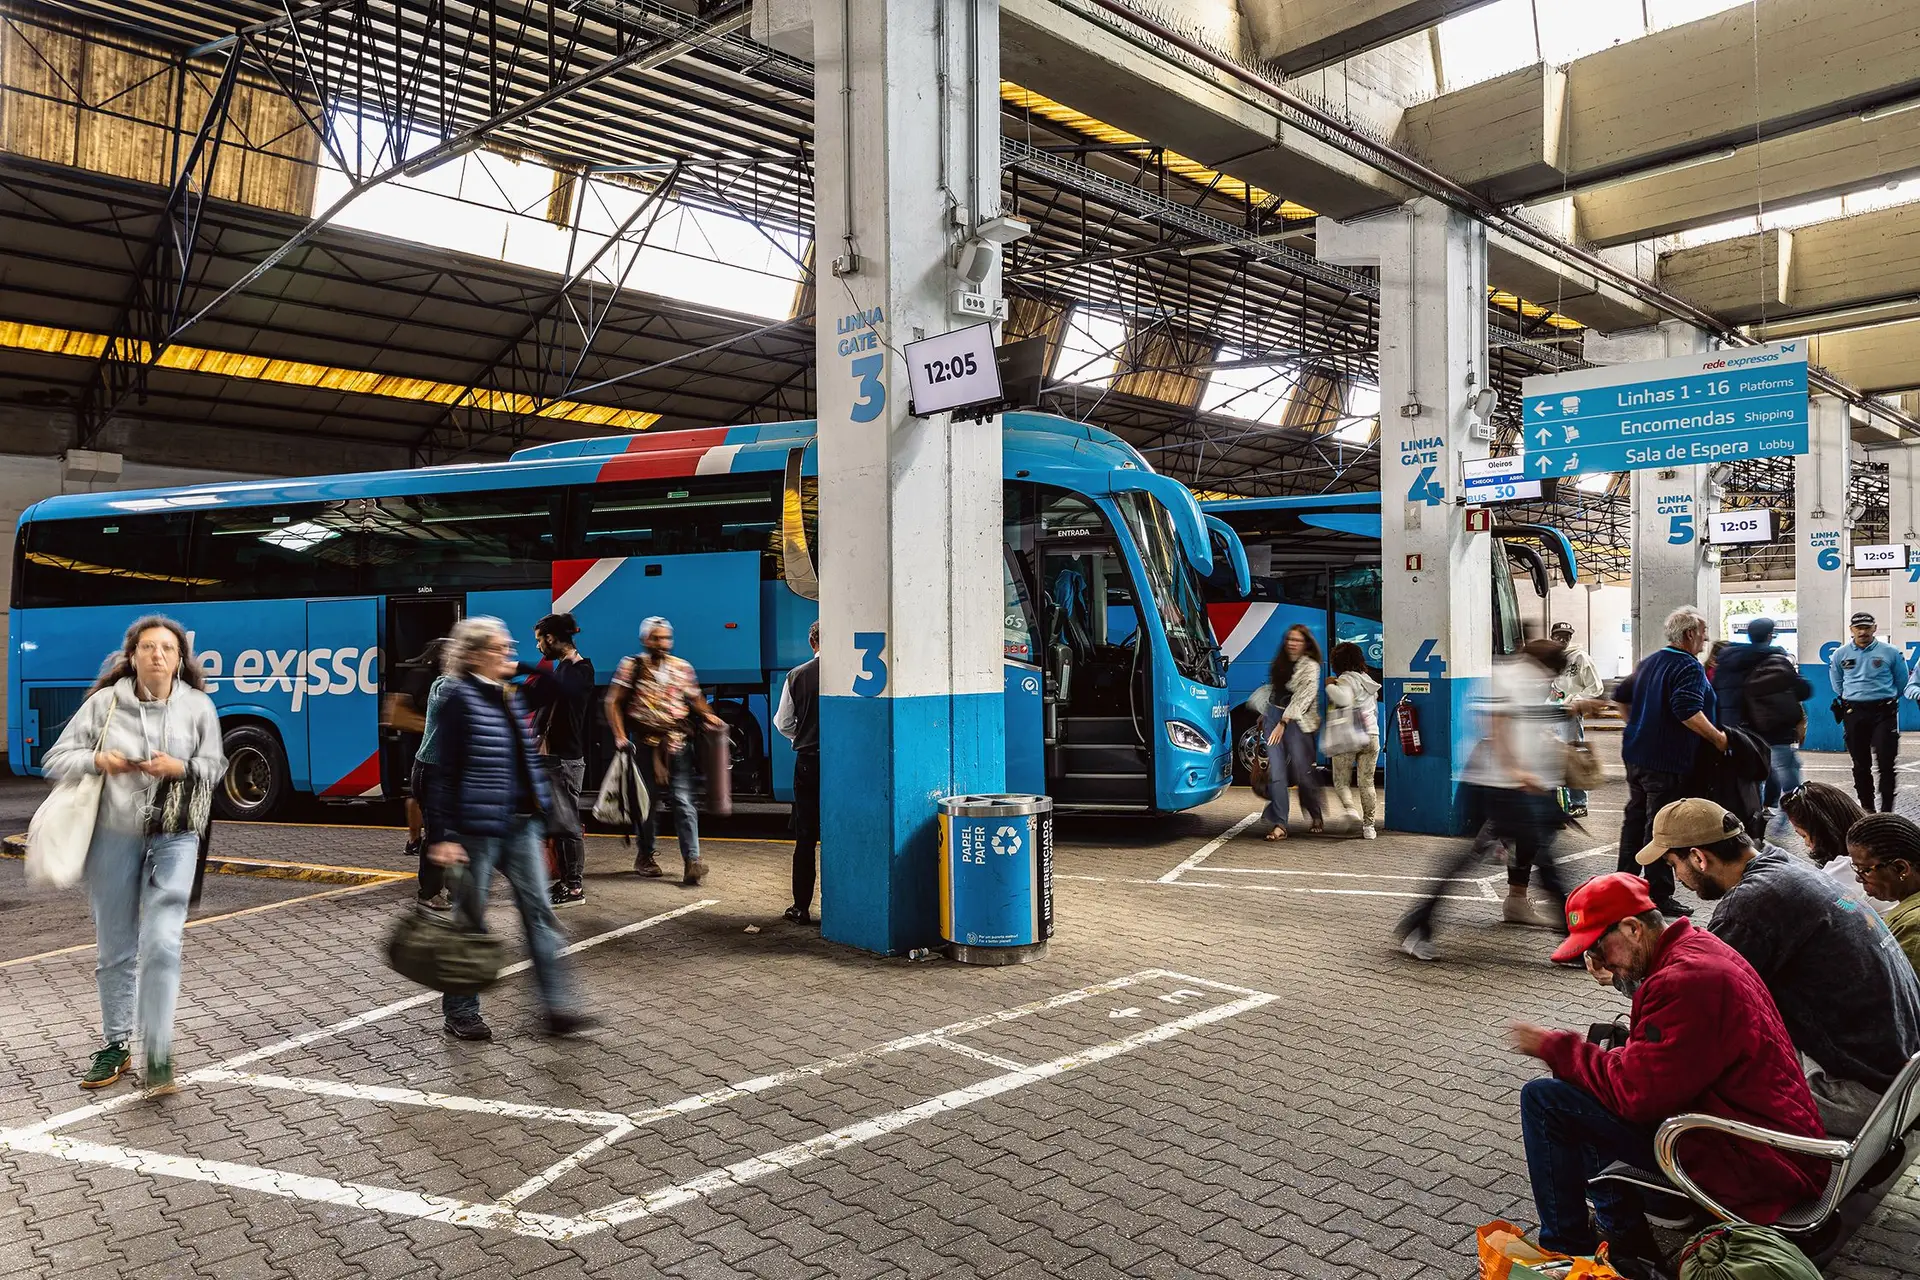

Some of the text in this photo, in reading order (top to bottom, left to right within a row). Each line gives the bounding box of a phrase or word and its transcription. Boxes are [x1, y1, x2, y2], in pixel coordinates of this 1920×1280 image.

[837, 307, 884, 335] LINHA
[837, 332, 878, 357] GATE
[923, 352, 978, 385] 12:05
[1702, 352, 1779, 370] rede expressos
[850, 353, 886, 423] 3
[1617, 388, 1675, 407] Linhas
[1680, 385, 1689, 399] 1
[1707, 380, 1730, 397] 16
[1740, 377, 1794, 393] Platforms
[1621, 408, 1794, 435] Encomendas Shipping
[1400, 436, 1445, 452] LINHA
[1626, 438, 1795, 464] Sala de Espera Lobby
[1400, 451, 1438, 466] GATE
[1488, 460, 1513, 469] Oleiros
[1407, 466, 1445, 507] 4
[1467, 485, 1516, 503] BUS 30
[1657, 495, 1693, 505] LINHA
[1657, 504, 1688, 515] GATE
[1057, 529, 1090, 538] ENTRADA
[1667, 515, 1695, 545] 5
[1720, 520, 1758, 532] 12:05
[1810, 531, 1840, 540] LINHA
[1810, 539, 1837, 548] GATE
[1817, 548, 1841, 571] 6
[1863, 552, 1895, 561] 12:05
[1905, 563, 1920, 583] 7
[851, 632, 888, 697] 3
[1409, 639, 1447, 678] 4
[962, 825, 972, 863] PAPEL
[975, 826, 986, 865] PAPER
[1043, 820, 1051, 921] INDIFERENCIADO
